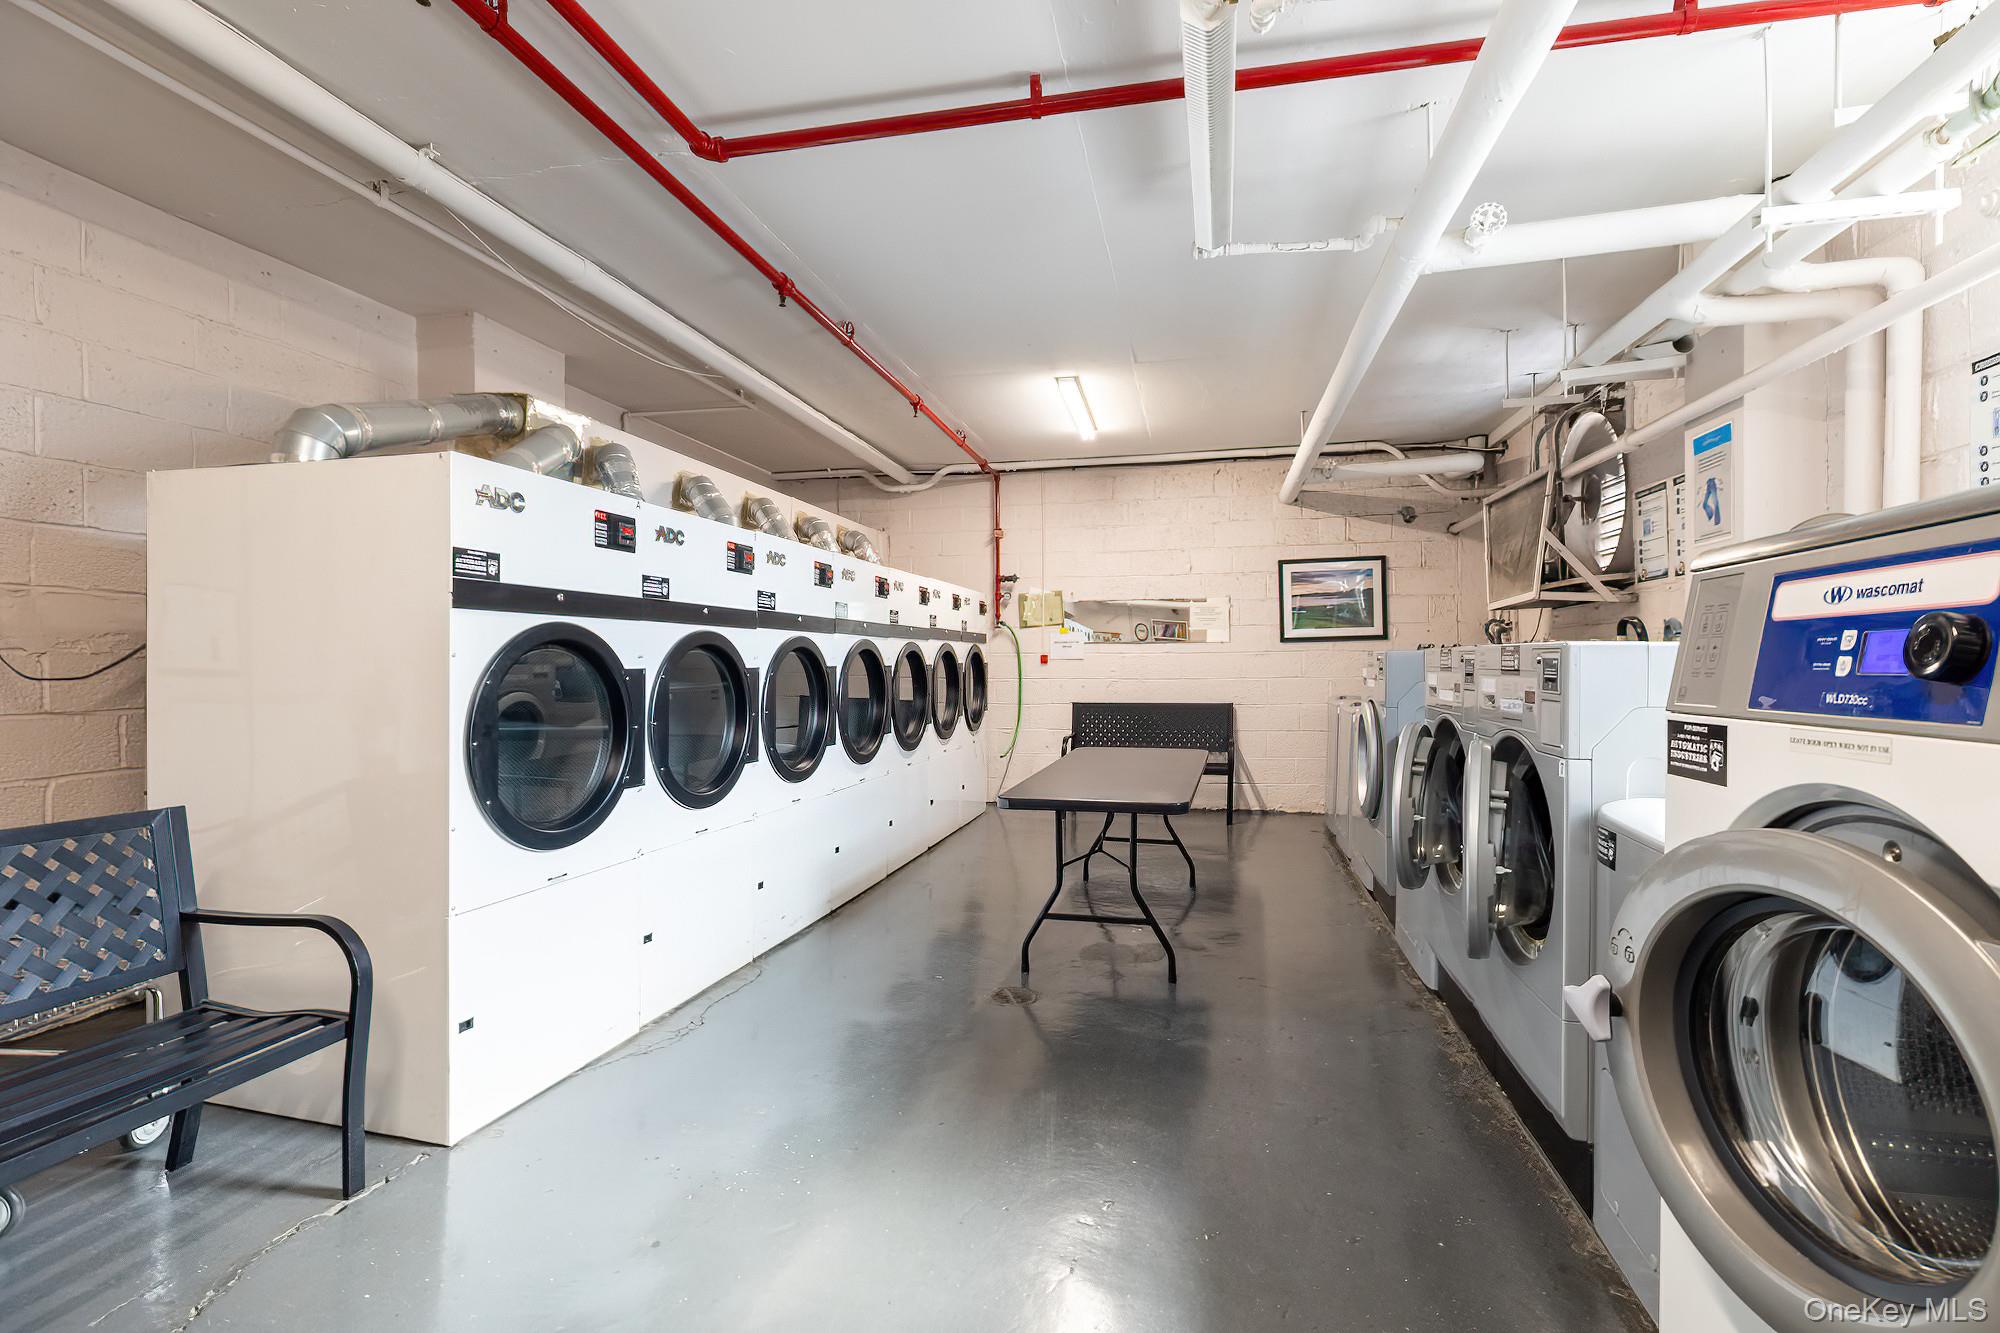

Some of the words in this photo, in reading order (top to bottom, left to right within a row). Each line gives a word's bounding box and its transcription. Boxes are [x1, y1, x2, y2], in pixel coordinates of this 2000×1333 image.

[475, 484, 526, 514] ADC
[655, 525, 685, 547] ADC
[766, 550, 786, 567] ADC
[1856, 578, 1924, 599] wascomat
